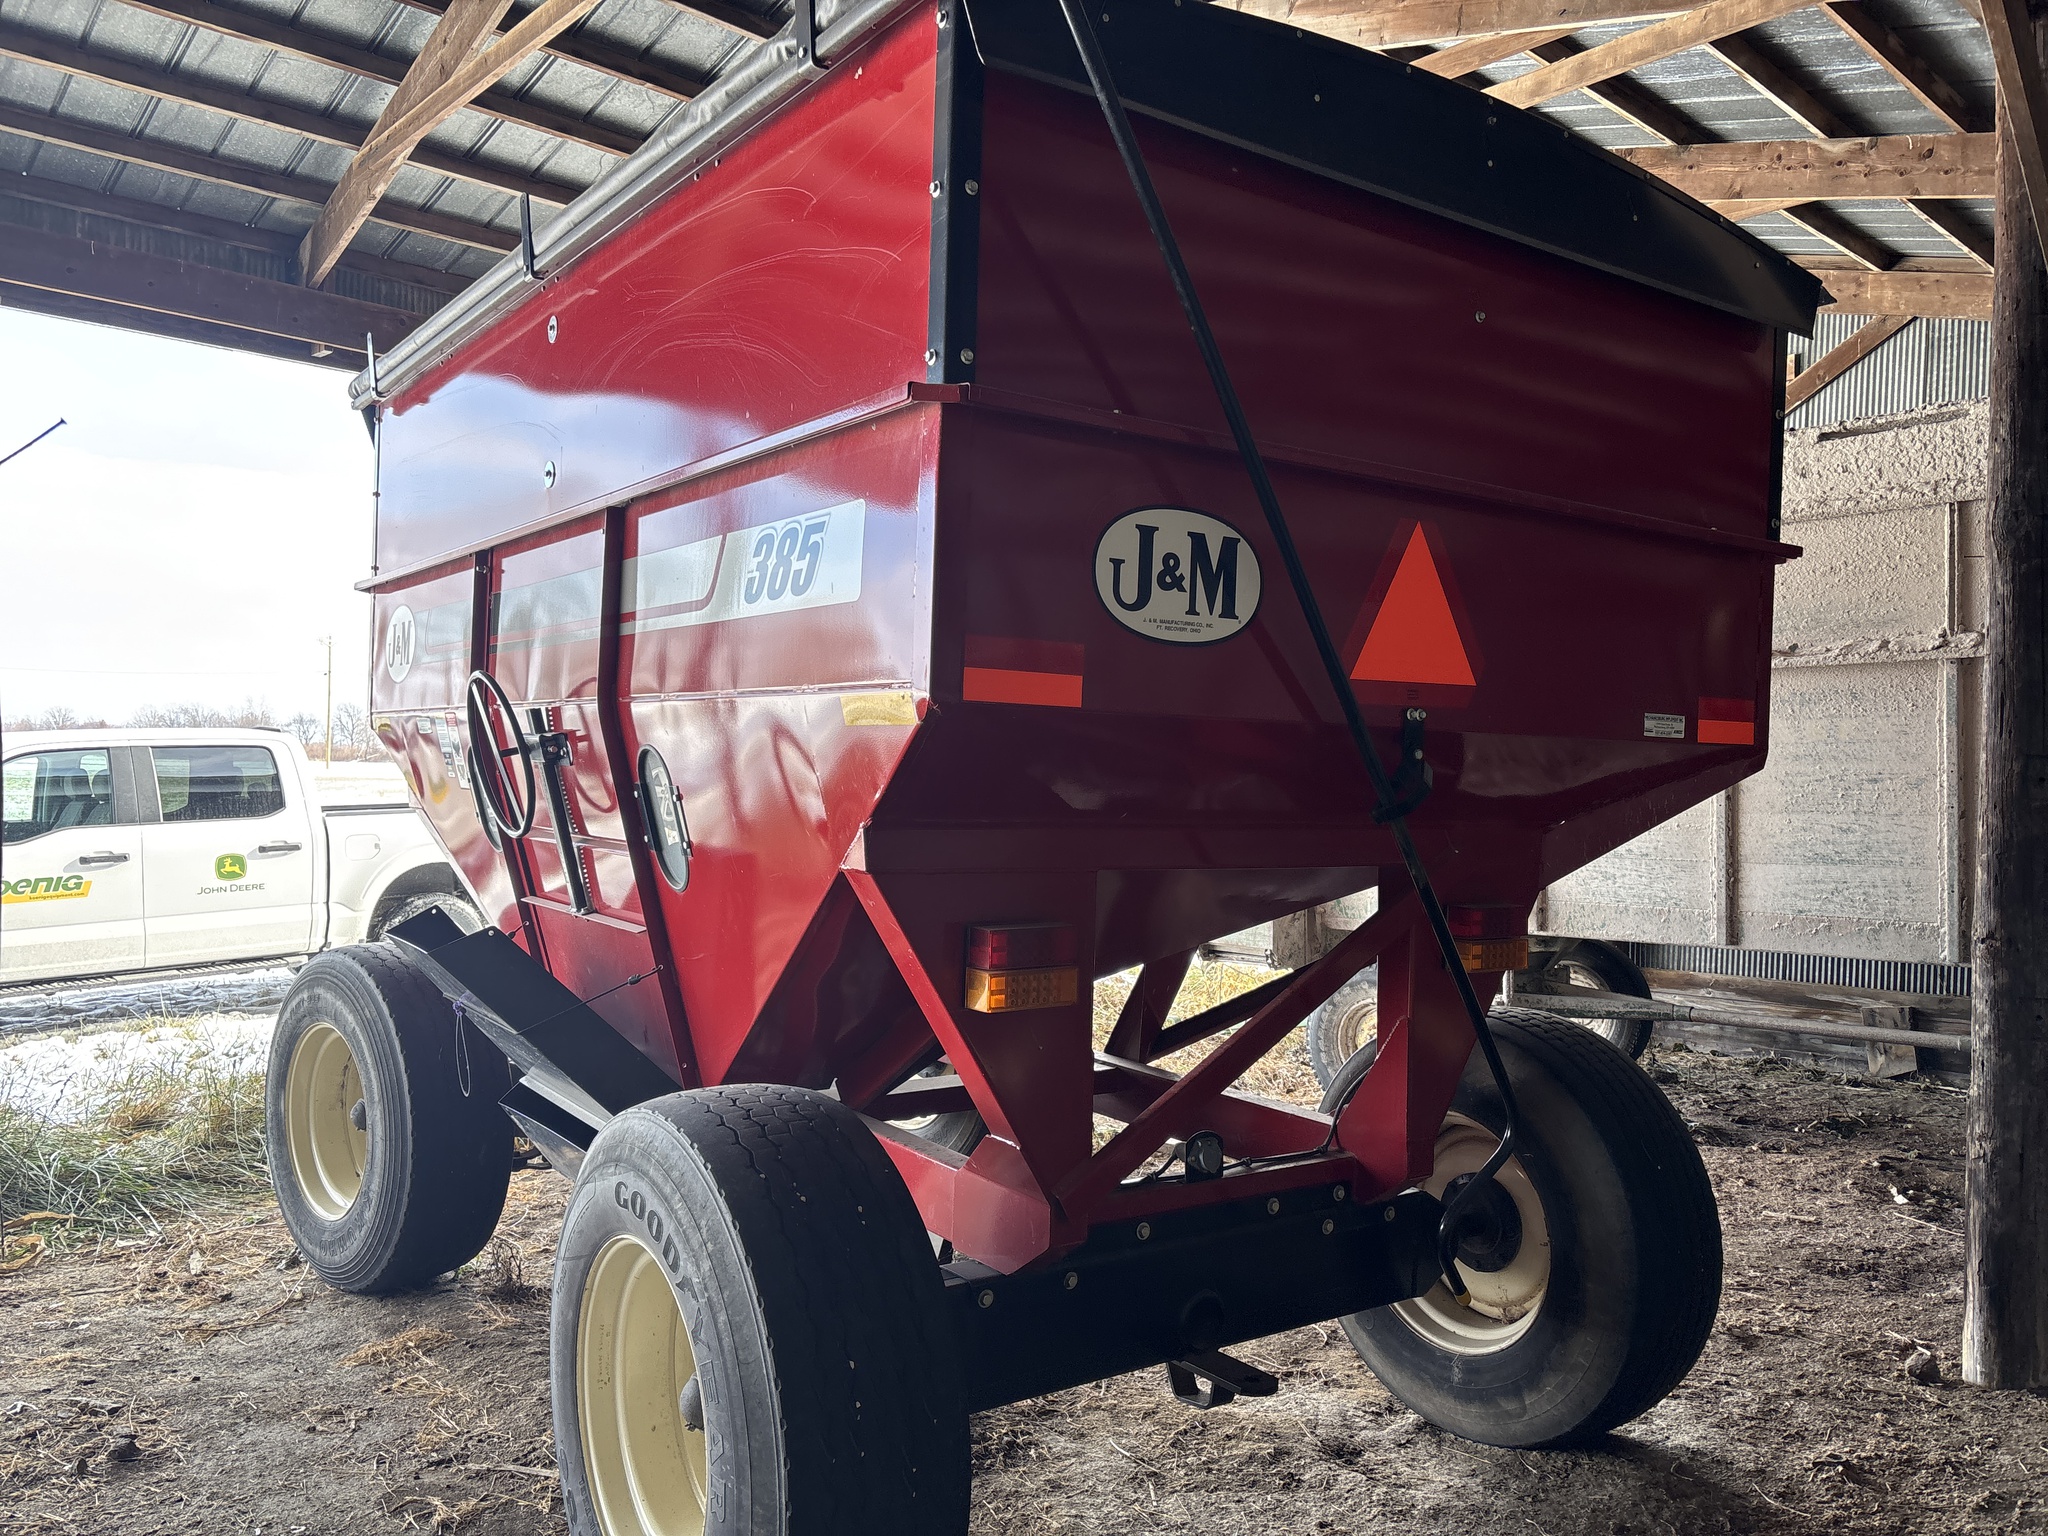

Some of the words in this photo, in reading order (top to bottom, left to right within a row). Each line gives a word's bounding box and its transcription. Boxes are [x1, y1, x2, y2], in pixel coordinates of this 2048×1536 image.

[744, 514, 830, 605] 385
[1108, 523, 1241, 620] J&M
[388, 620, 412, 669] J&M
[1159, 618, 1196, 627] MANUFACTURING
[29, 892, 85, 900] koenigequipment.com
[614, 1180, 726, 1523] GOODYEAR
